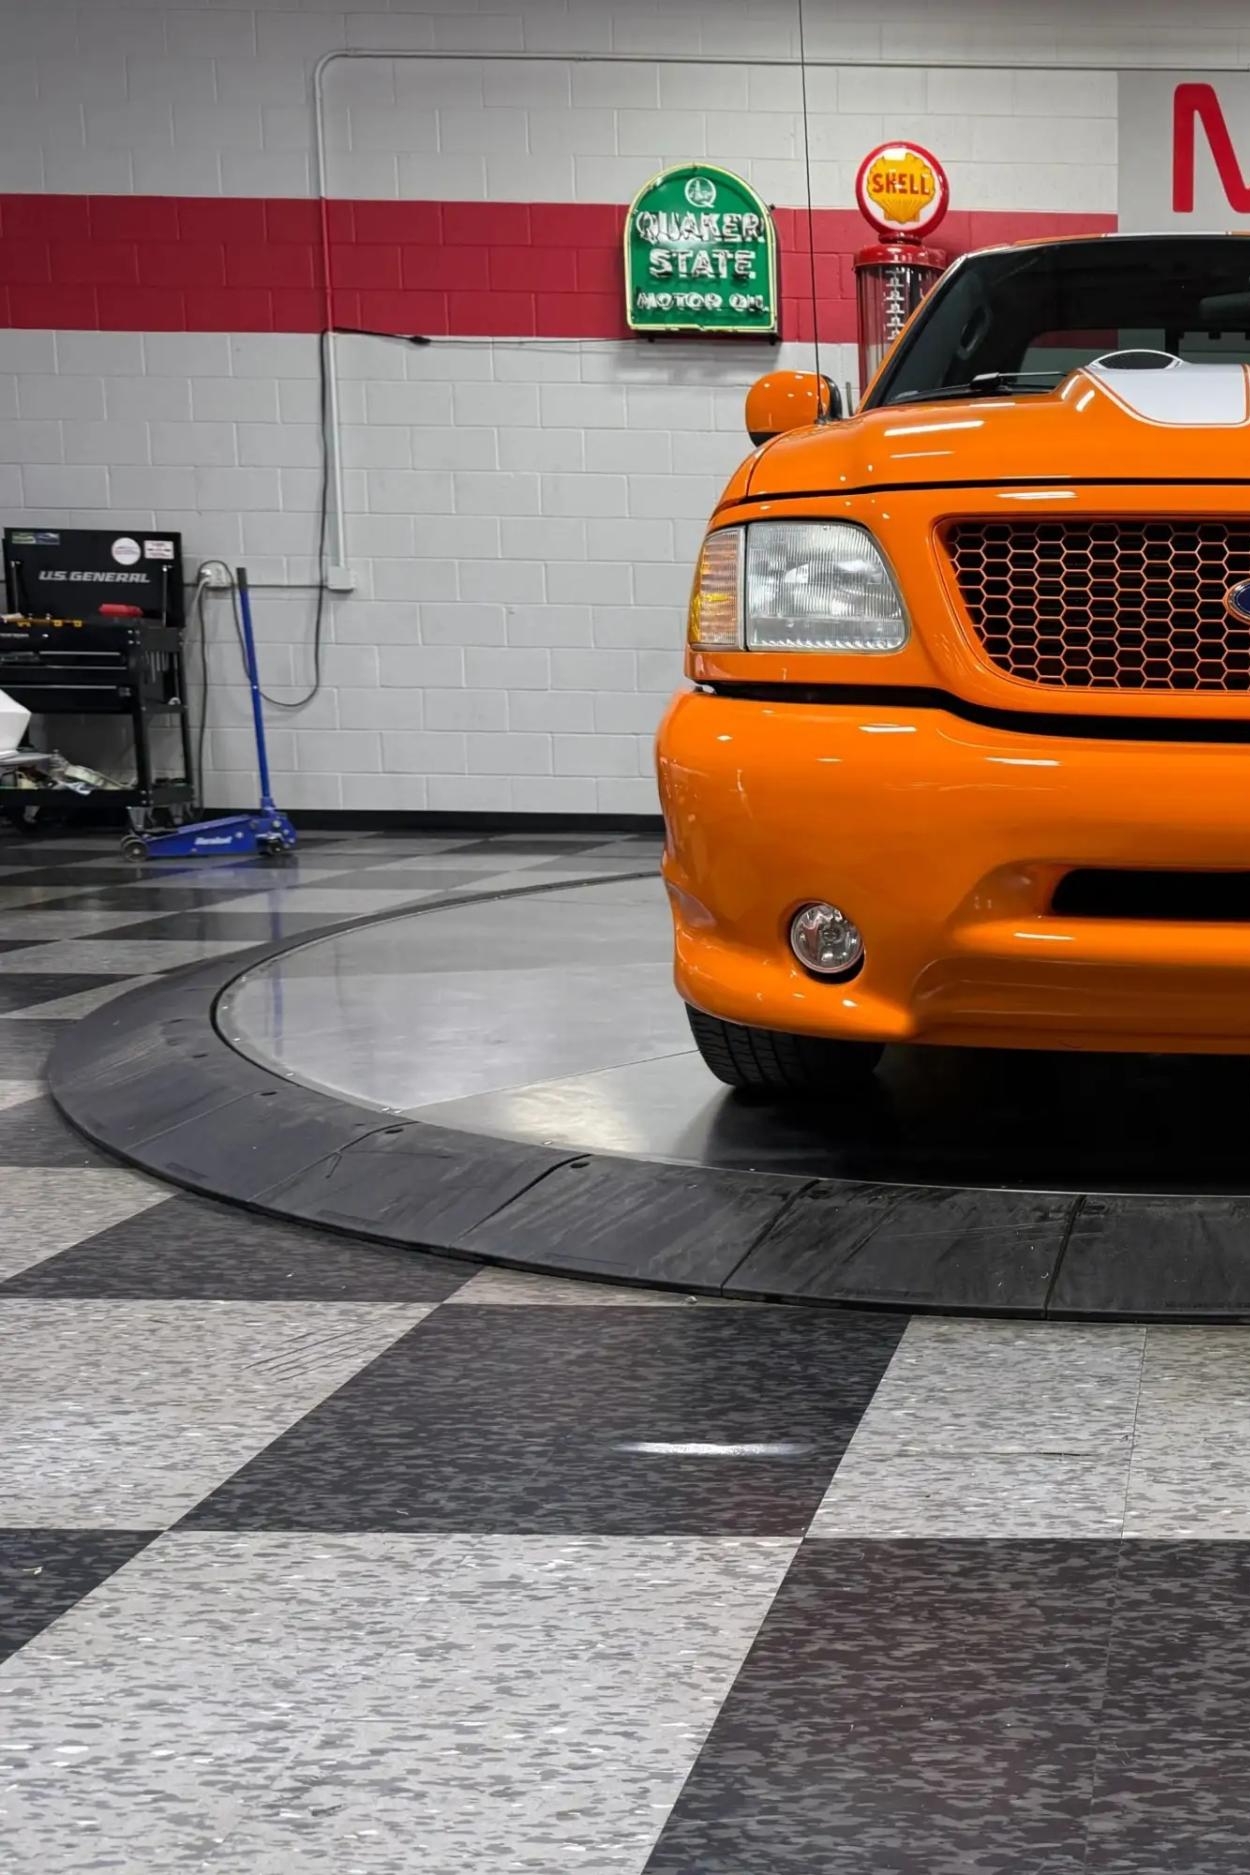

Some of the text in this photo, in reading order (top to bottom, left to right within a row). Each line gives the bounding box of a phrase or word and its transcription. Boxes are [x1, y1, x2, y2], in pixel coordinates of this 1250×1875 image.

[871, 172, 931, 196] SHELL
[636, 211, 766, 244] QUAKER
[649, 249, 757, 279] STATE
[637, 291, 723, 311] MOTOR
[69, 571, 151, 583] GENERAL
